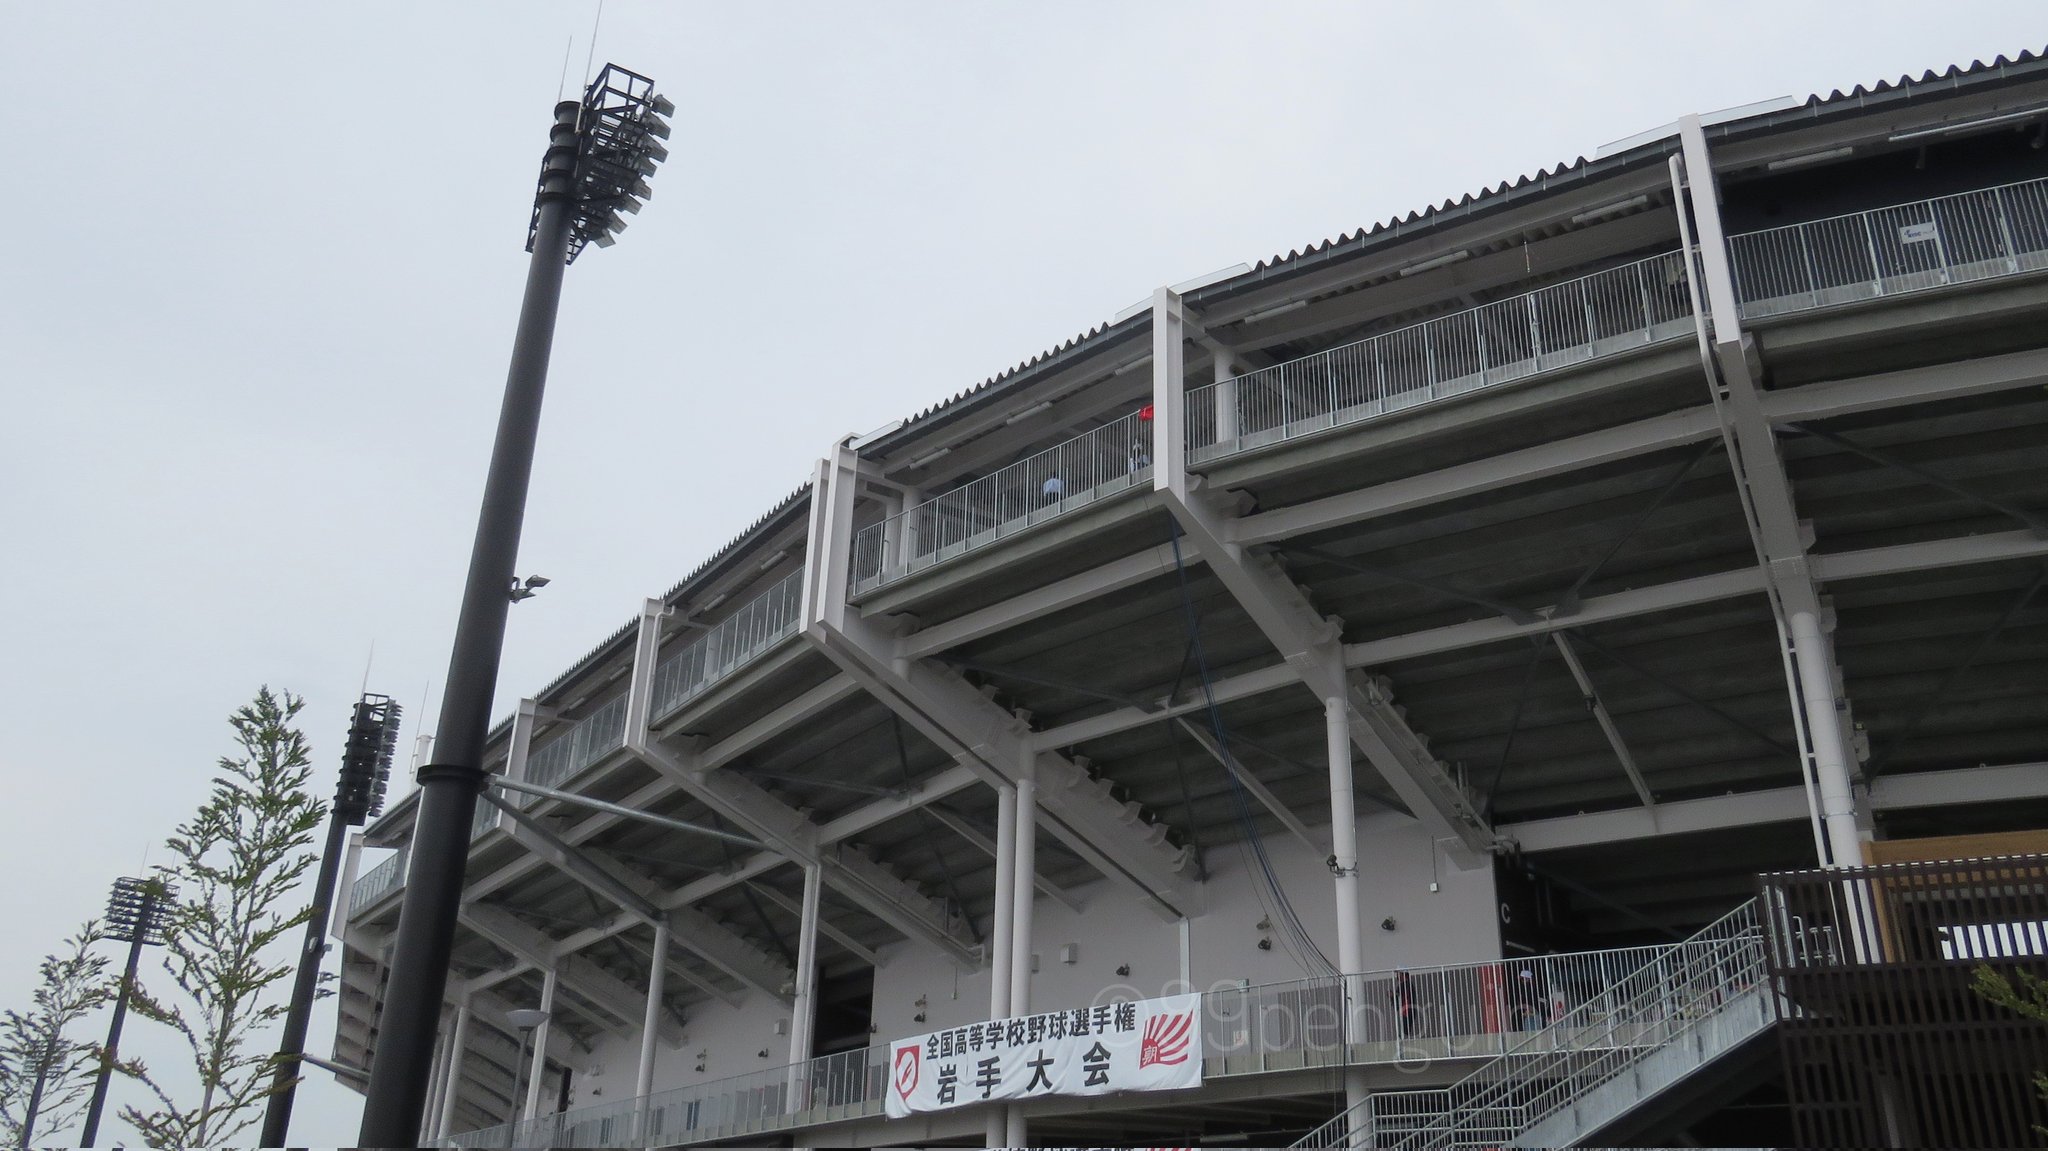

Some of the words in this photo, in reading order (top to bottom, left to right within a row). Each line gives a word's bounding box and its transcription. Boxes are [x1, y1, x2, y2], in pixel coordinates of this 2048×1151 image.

[1501, 902, 1511, 923] C
[926, 1002, 1135, 1060] 全国高等学校野球選手権
